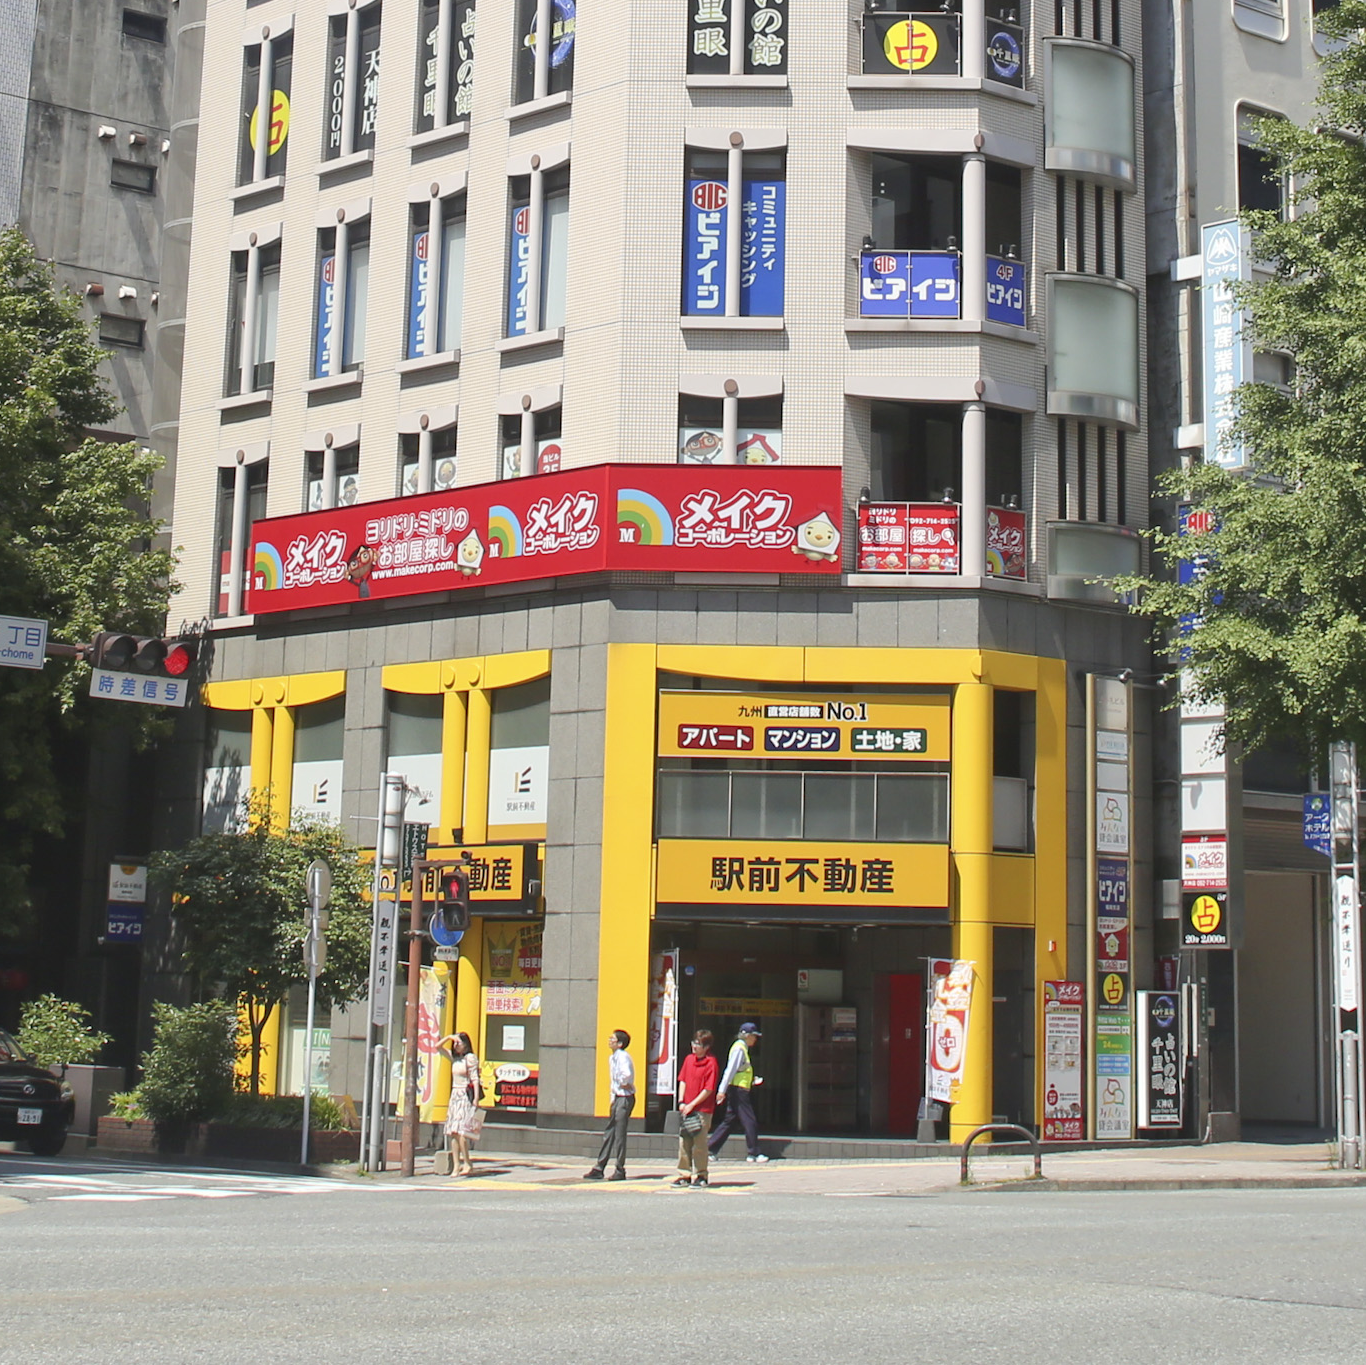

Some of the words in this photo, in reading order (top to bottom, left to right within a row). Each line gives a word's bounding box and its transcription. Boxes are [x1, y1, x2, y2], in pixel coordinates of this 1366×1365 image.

[893, 22, 929, 67] 占
[761, 184, 777, 272] コミュニティ
[741, 199, 759, 289] キャッシング
[873, 255, 897, 275] BIG
[994, 264, 1015, 281] 4F
[525, 491, 599, 533] メイク
[678, 486, 794, 534] メイク
[868, 507, 897, 516] ヨリドリ
[868, 515, 897, 525] ミドリの
[365, 507, 469, 544] ヨリドリ・ミドリの
[618, 526, 635, 543] M
[676, 524, 795, 551] コーポレーション
[988, 527, 1022, 546] メイク
[285, 531, 346, 571] メイク
[378, 537, 455, 567] お部屋探し
[523, 527, 599, 555] コーポレーション
[285, 561, 347, 586] コーポレーション
[371, 560, 454, 581] www.makecorp.com
[98, 675, 180, 701] 時差信号
[737, 703, 763, 720] 九州
[765, 704, 823, 719] 直営店舗数
[826, 700, 868, 722] No.1
[680, 728, 752, 749] アパート
[767, 729, 838, 749] マンション
[853, 729, 924, 752] 土地・家
[1304, 823, 1330, 833] ホテル
[1305, 812, 1330, 823] アーク
[1198, 852, 1225, 864] メイク
[709, 856, 894, 894] 駅前不動産
[1196, 897, 1216, 929] 占
[1058, 984, 1080, 996] メイク
[1107, 975, 1121, 1001] 占
[1150, 1036, 1165, 1091] 千里眼
[1163, 1032, 1178, 1096] 占いの館
